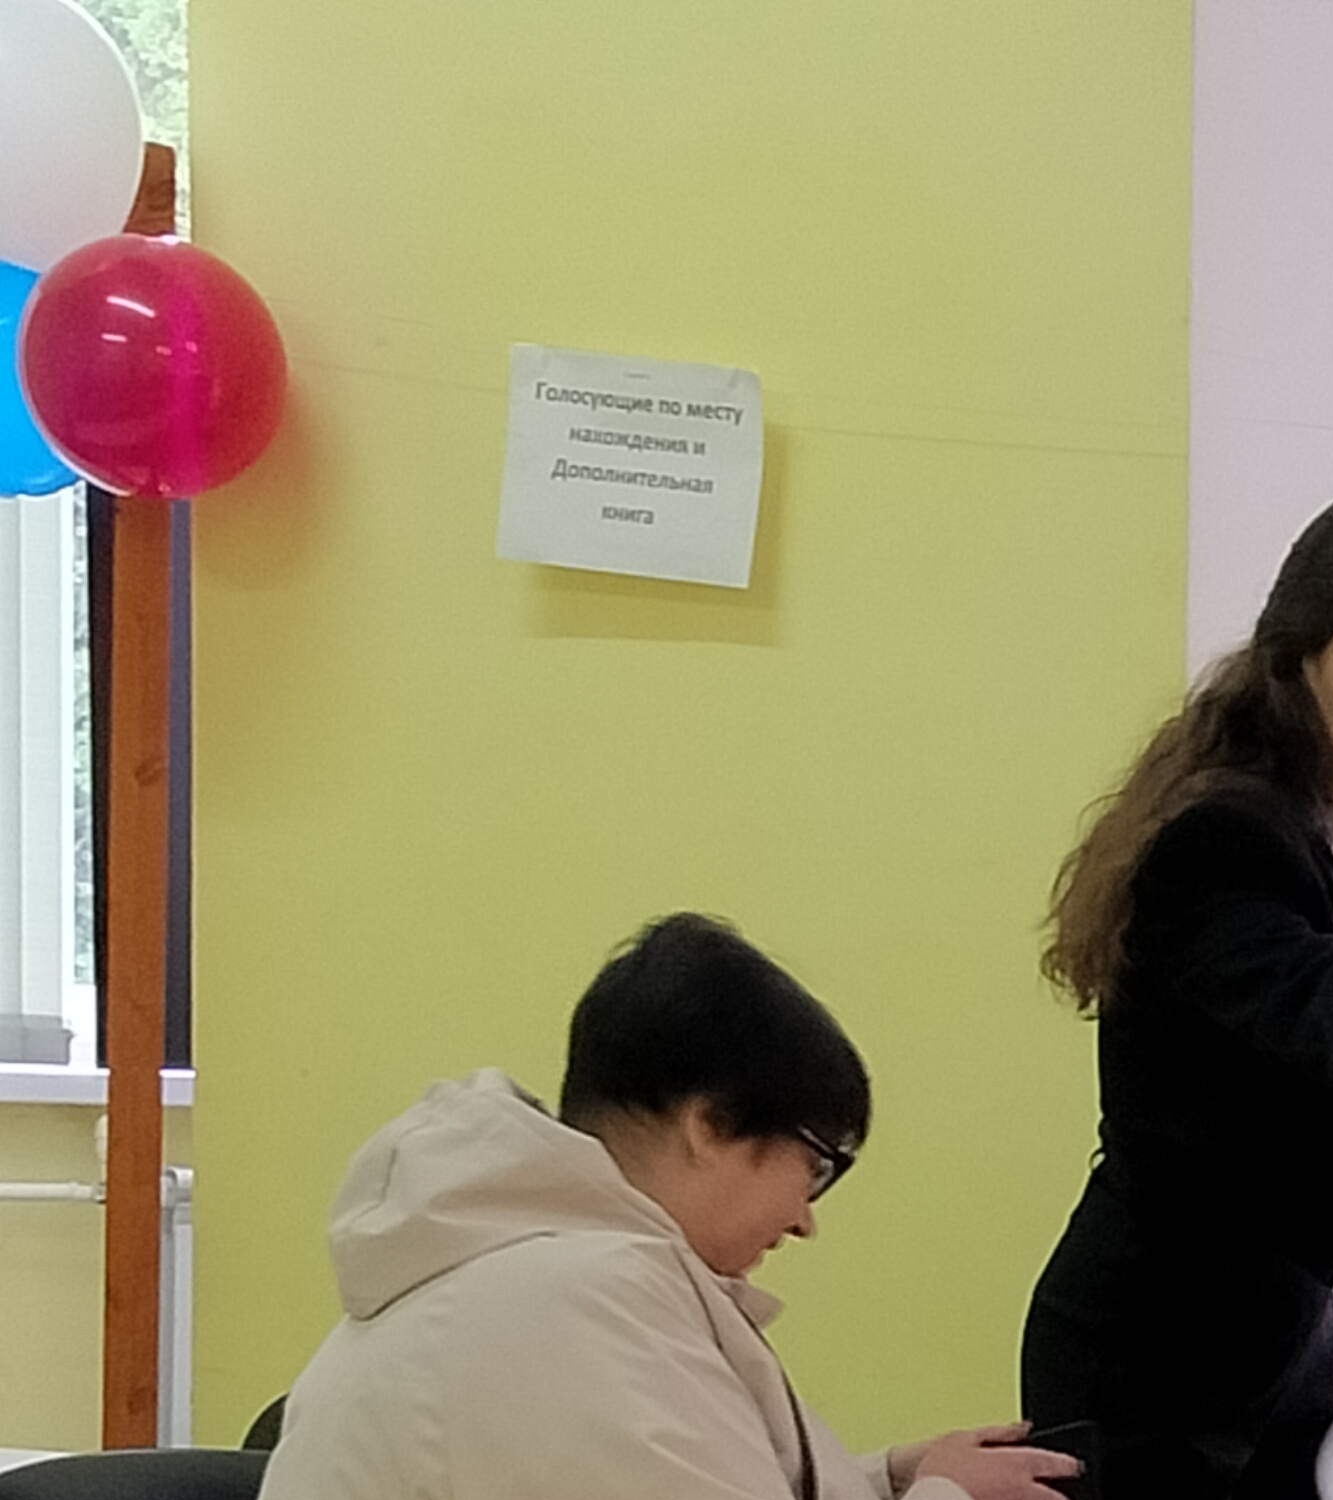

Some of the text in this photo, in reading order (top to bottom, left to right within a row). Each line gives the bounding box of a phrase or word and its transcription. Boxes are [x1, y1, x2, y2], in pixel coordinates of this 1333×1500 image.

[535, 382, 743, 425] Голосующие по месту
[569, 428, 705, 455] нахождения и
[551, 459, 713, 493] Дополнительная
[601, 506, 654, 525] книга
